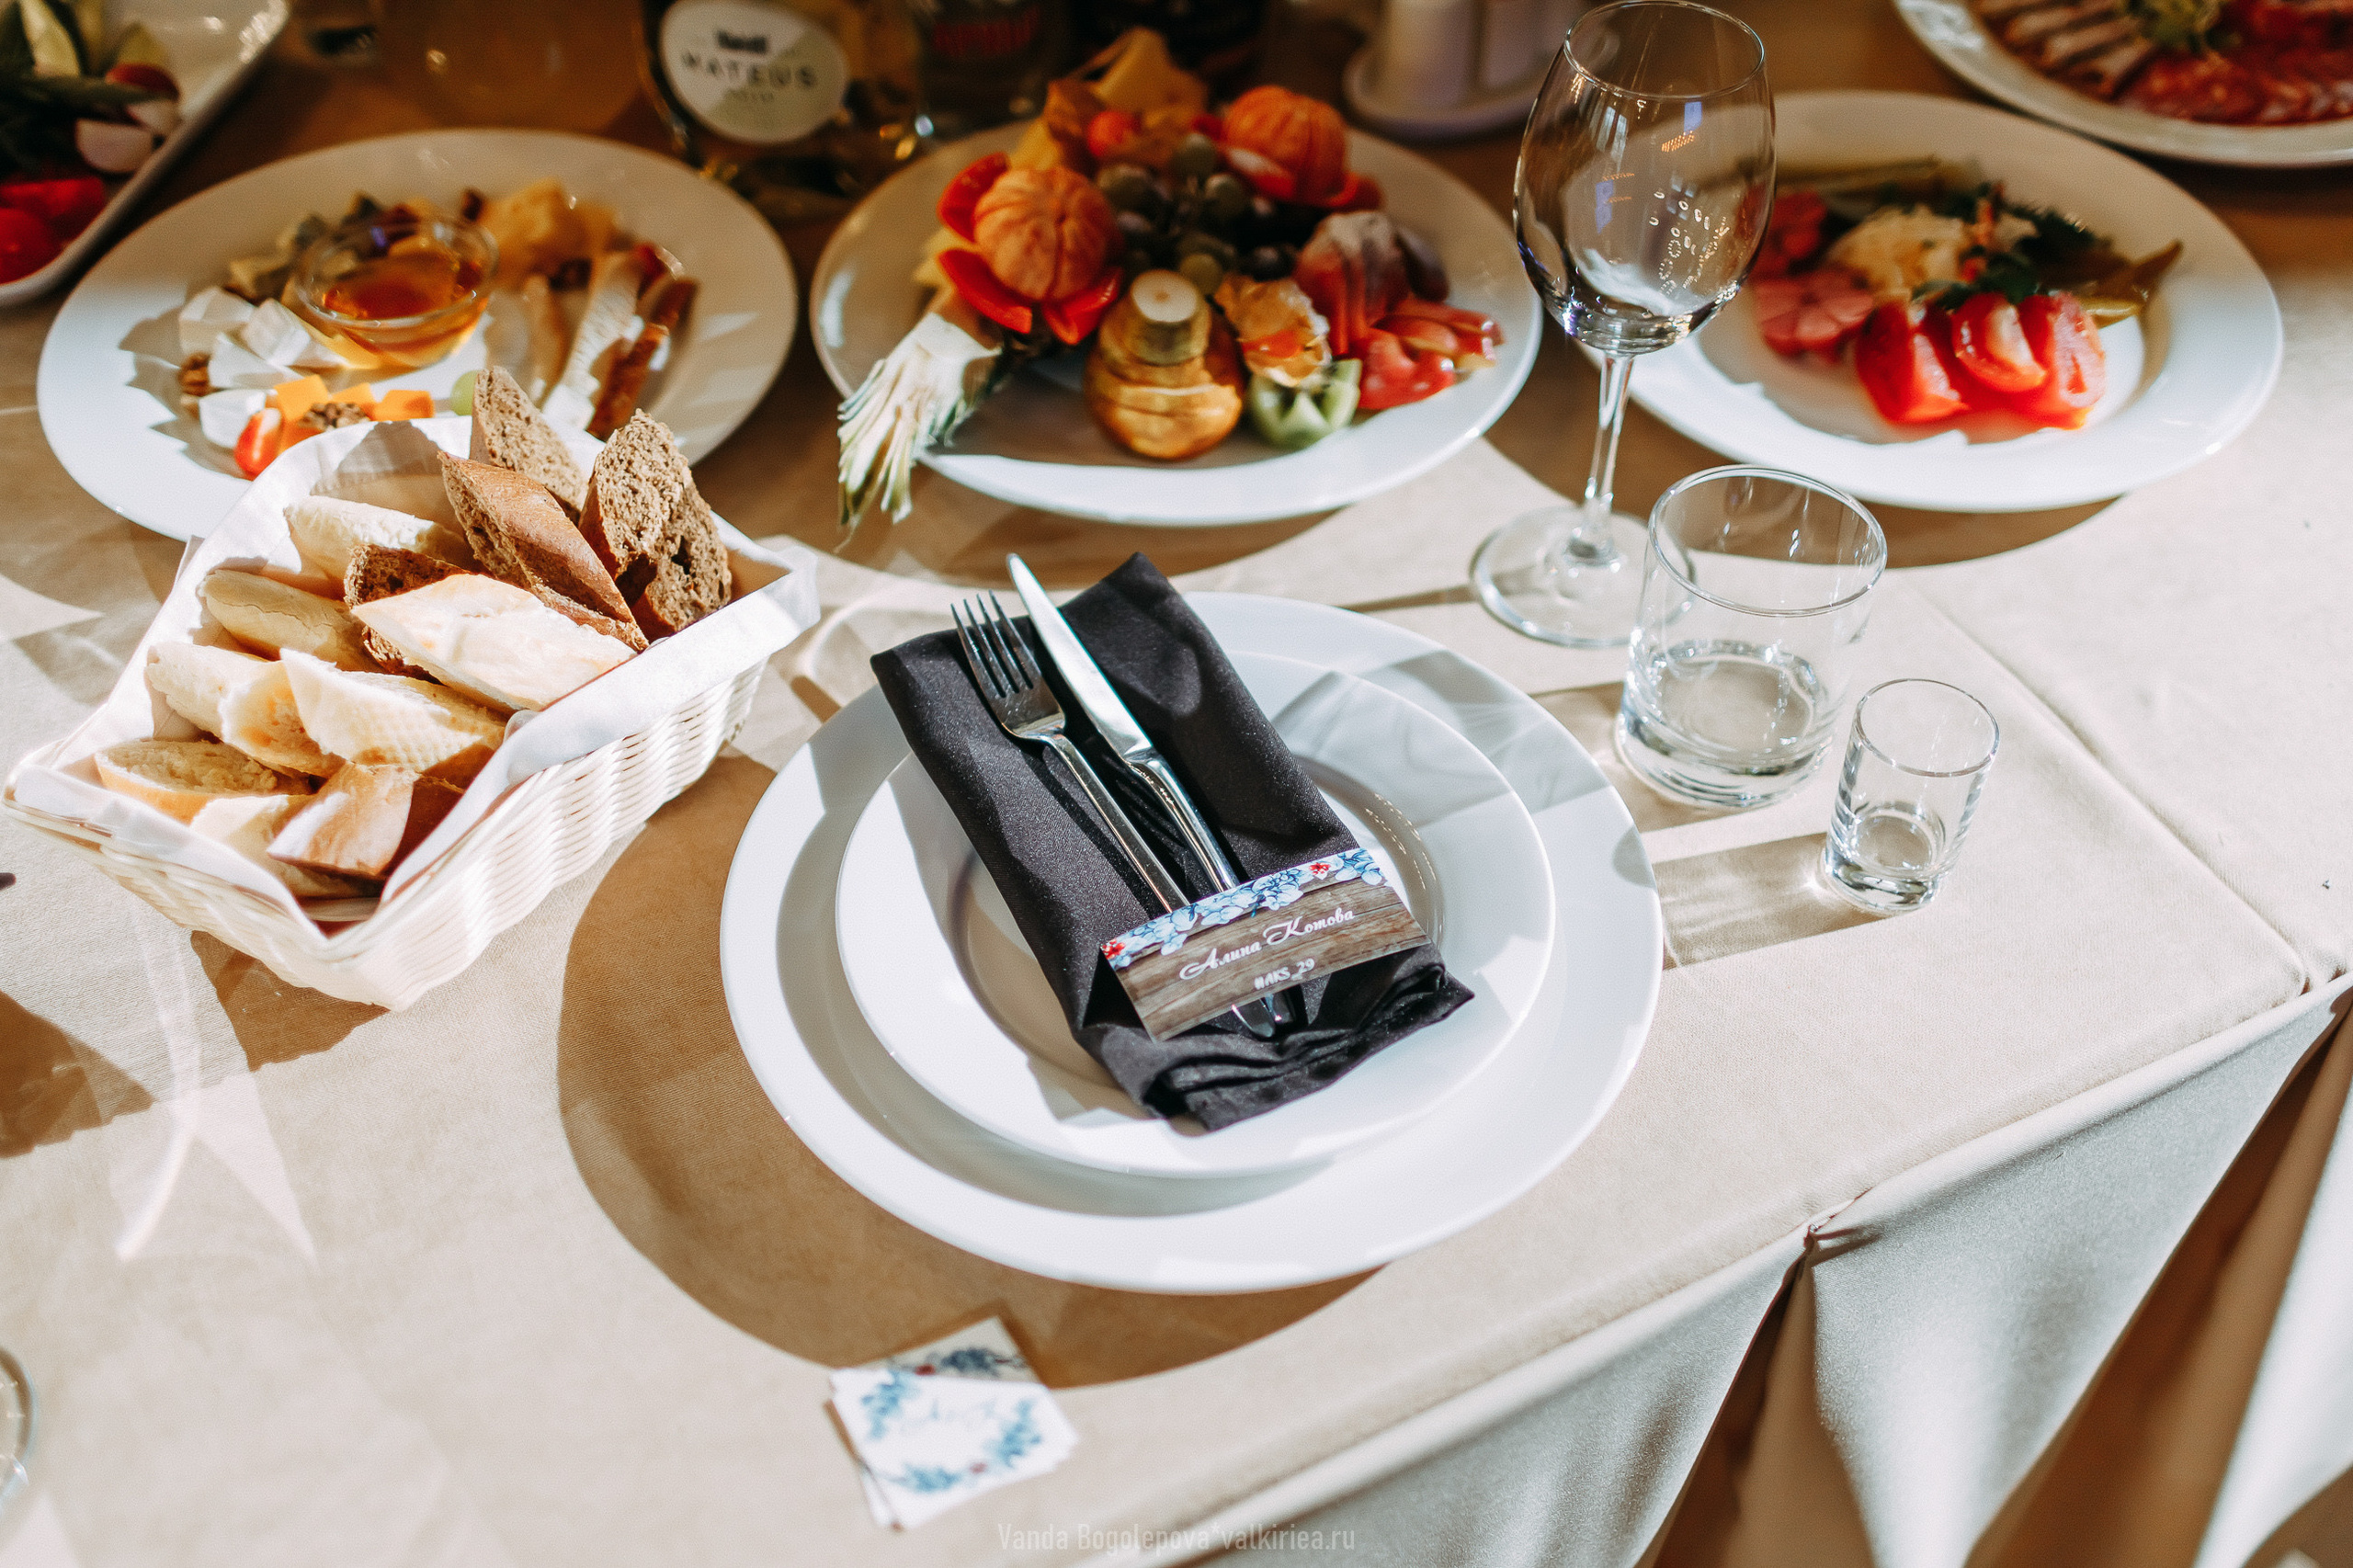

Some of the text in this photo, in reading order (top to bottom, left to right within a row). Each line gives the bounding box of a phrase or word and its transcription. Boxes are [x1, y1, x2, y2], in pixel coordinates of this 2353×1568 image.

[680, 49, 818, 89] MATEUS
[1179, 907, 1355, 981] Алина Котова
